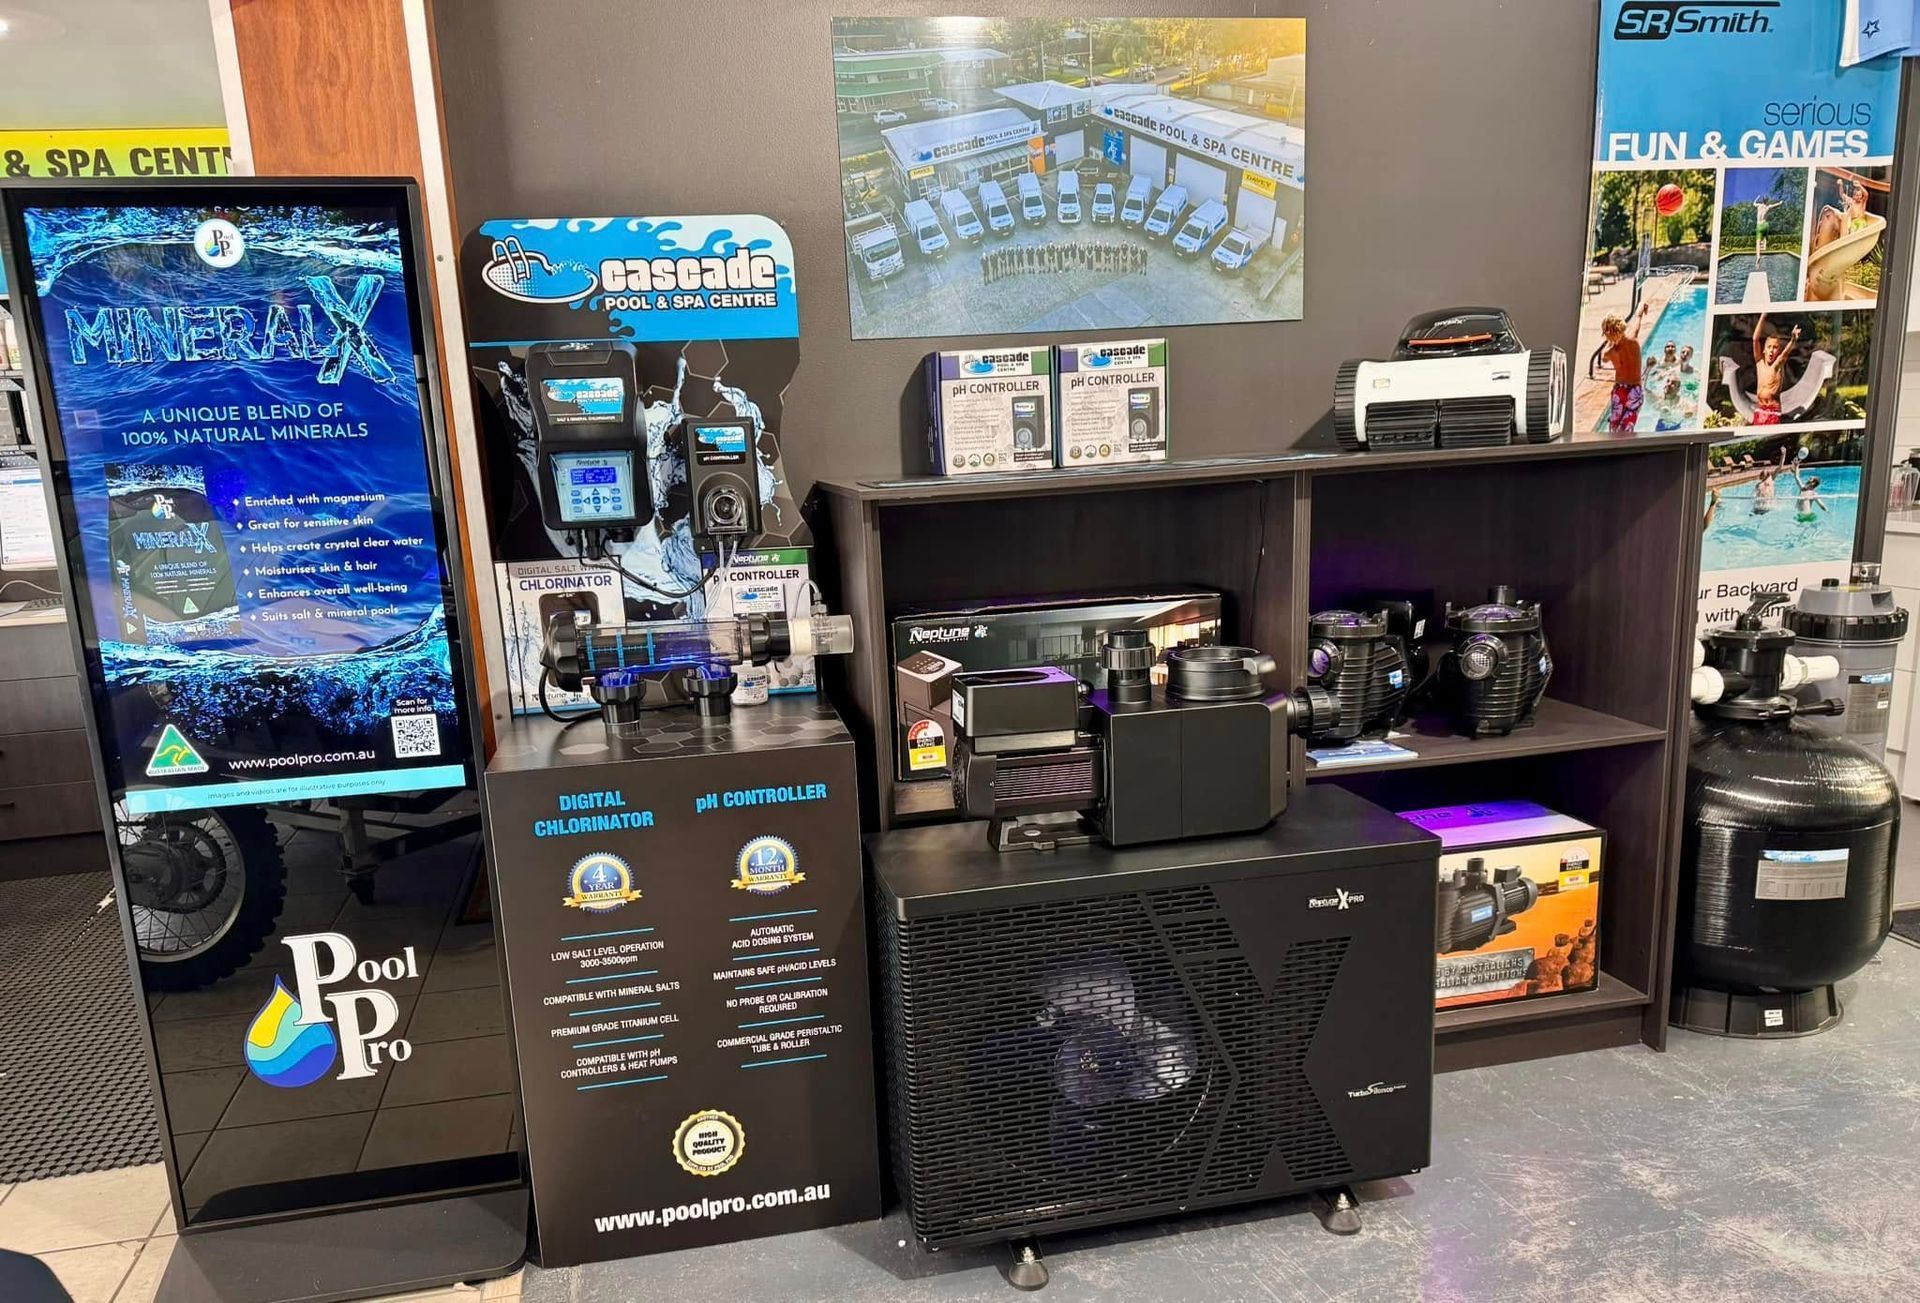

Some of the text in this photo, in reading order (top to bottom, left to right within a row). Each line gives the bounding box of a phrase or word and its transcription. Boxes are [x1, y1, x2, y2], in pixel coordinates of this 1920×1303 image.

[1764, 96, 1871, 126] serious
[933, 136, 985, 158] cascade
[1114, 108, 1294, 179] cascade POOL & SPA CENTRE
[1608, 129, 1868, 161] FUN & GAMES
[4, 149, 30, 177] &
[45, 149, 115, 176] SPA
[600, 246, 777, 293] cascade
[604, 292, 777, 311] POOL & SPA CENTRE
[982, 352, 1029, 364] cascade
[1100, 345, 1145, 357] cascade
[953, 381, 1039, 397] pH CONTROLLER
[1071, 373, 1155, 390] pH CONTROLLER
[142, 403, 344, 423] A UNIQUE BLEND OF
[121, 423, 368, 446] 100% NATURAL MINERALS
[245, 493, 385, 506] Enriched with magnesium
[248, 515, 373, 530] Great for sensitive skin
[252, 537, 424, 554] Helps create crystal clear water
[733, 553, 768, 563] Neptune
[255, 561, 377, 576] Moisturises skin & hair
[517, 565, 576, 575] DIGITAL SALT
[730, 569, 800, 582] CONTROLLER
[259, 582, 407, 599] Enhances overall well-being
[520, 575, 612, 591] CHLORINATOR
[262, 605, 399, 622] Suits salt & mineral pools
[1706, 607, 1740, 622] with
[908, 627, 970, 642] Neptune
[228, 750, 375, 770] www.poolpro.com.au
[560, 790, 626, 811] DIGITAL
[696, 783, 827, 813] pH CONTROLLER
[534, 811, 654, 837] CHLORINATOR
[754, 847, 778, 867] 12
[592, 863, 607, 882] 4
[748, 873, 788, 882] WARRANTY
[750, 864, 785, 874] MONTH
[588, 882, 615, 891] YEAR
[581, 891, 623, 900] WARRANTY
[750, 924, 794, 937] AUTOMATIC
[732, 932, 814, 949] ACID DOSING SYSTEM
[551, 941, 664, 961] LOW SALT LEVEL OPERATION
[580, 955, 638, 968] 3000-3500ppm
[713, 958, 836, 980] MAINTAINS SAFE pH/ACID LEVELS
[1444, 958, 1523, 977] BY AUSTRALIANS
[280, 932, 419, 1027] Pool
[1472, 968, 1527, 985] CONDITIONS
[543, 981, 680, 1006] COMPATIBLE WITH MINERAL SALTS
[726, 988, 828, 1008] NO PROBE OR CALIBRATION
[759, 1002, 797, 1014] REQUIRED
[324, 988, 413, 1080] Pro
[551, 1014, 679, 1038] PREMIUM GRADE TITANIUM CELL
[717, 1024, 843, 1048] COMMERCIAL GRADE PERISTALTIC
[751, 1043, 771, 1053] TUBE
[781, 1039, 810, 1050] ROLLER
[576, 1048, 660, 1067] COMPATIBLE WITH pH
[560, 1064, 618, 1079] CONTROLLERS
[628, 1060, 648, 1070] HEAT
[650, 1056, 678, 1066] PUMPS
[692, 1146, 726, 1155] PRODUCT
[693, 1138, 725, 1148] QUALITY
[595, 1183, 831, 1233] www.poolpro.com.au
